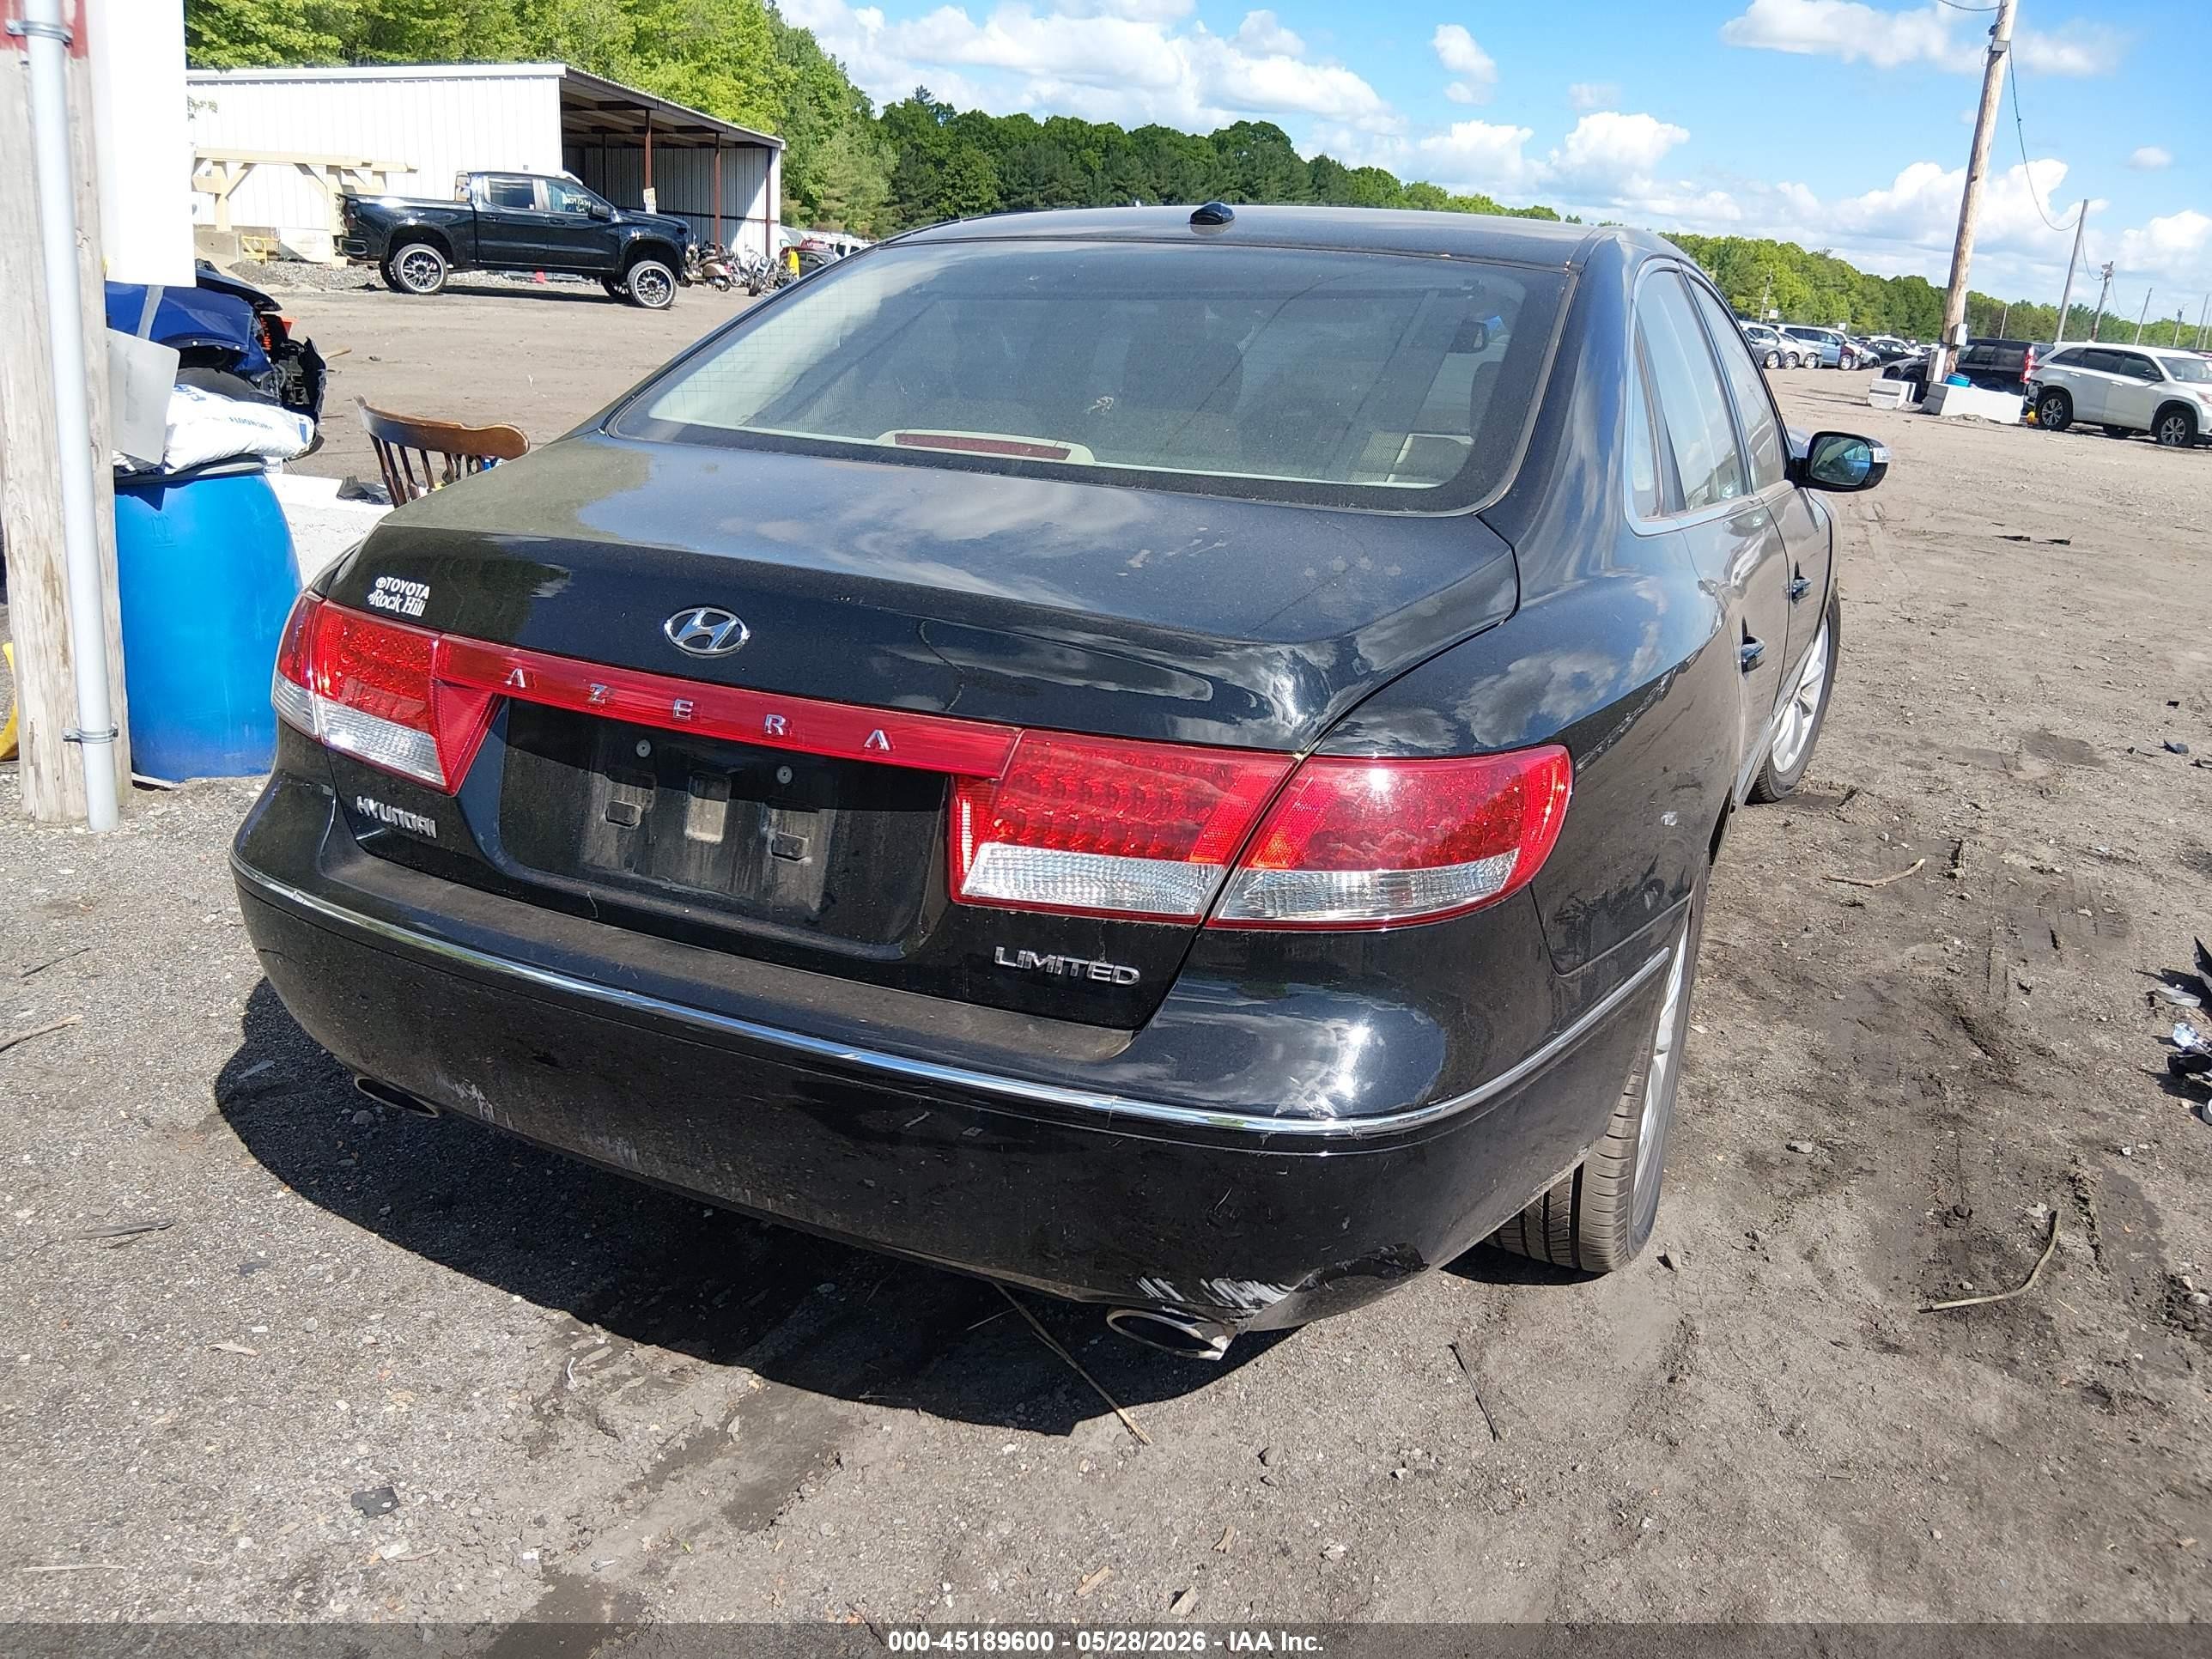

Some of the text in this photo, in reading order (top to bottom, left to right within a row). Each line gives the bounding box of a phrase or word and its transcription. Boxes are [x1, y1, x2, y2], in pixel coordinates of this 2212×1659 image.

[368, 589, 427, 617] Rock Hill
[384, 577, 430, 599] TOYOTA
[505, 668, 891, 751] AZERA
[356, 795, 437, 838] HYUNDAI
[994, 946, 1140, 985] LIMITED
